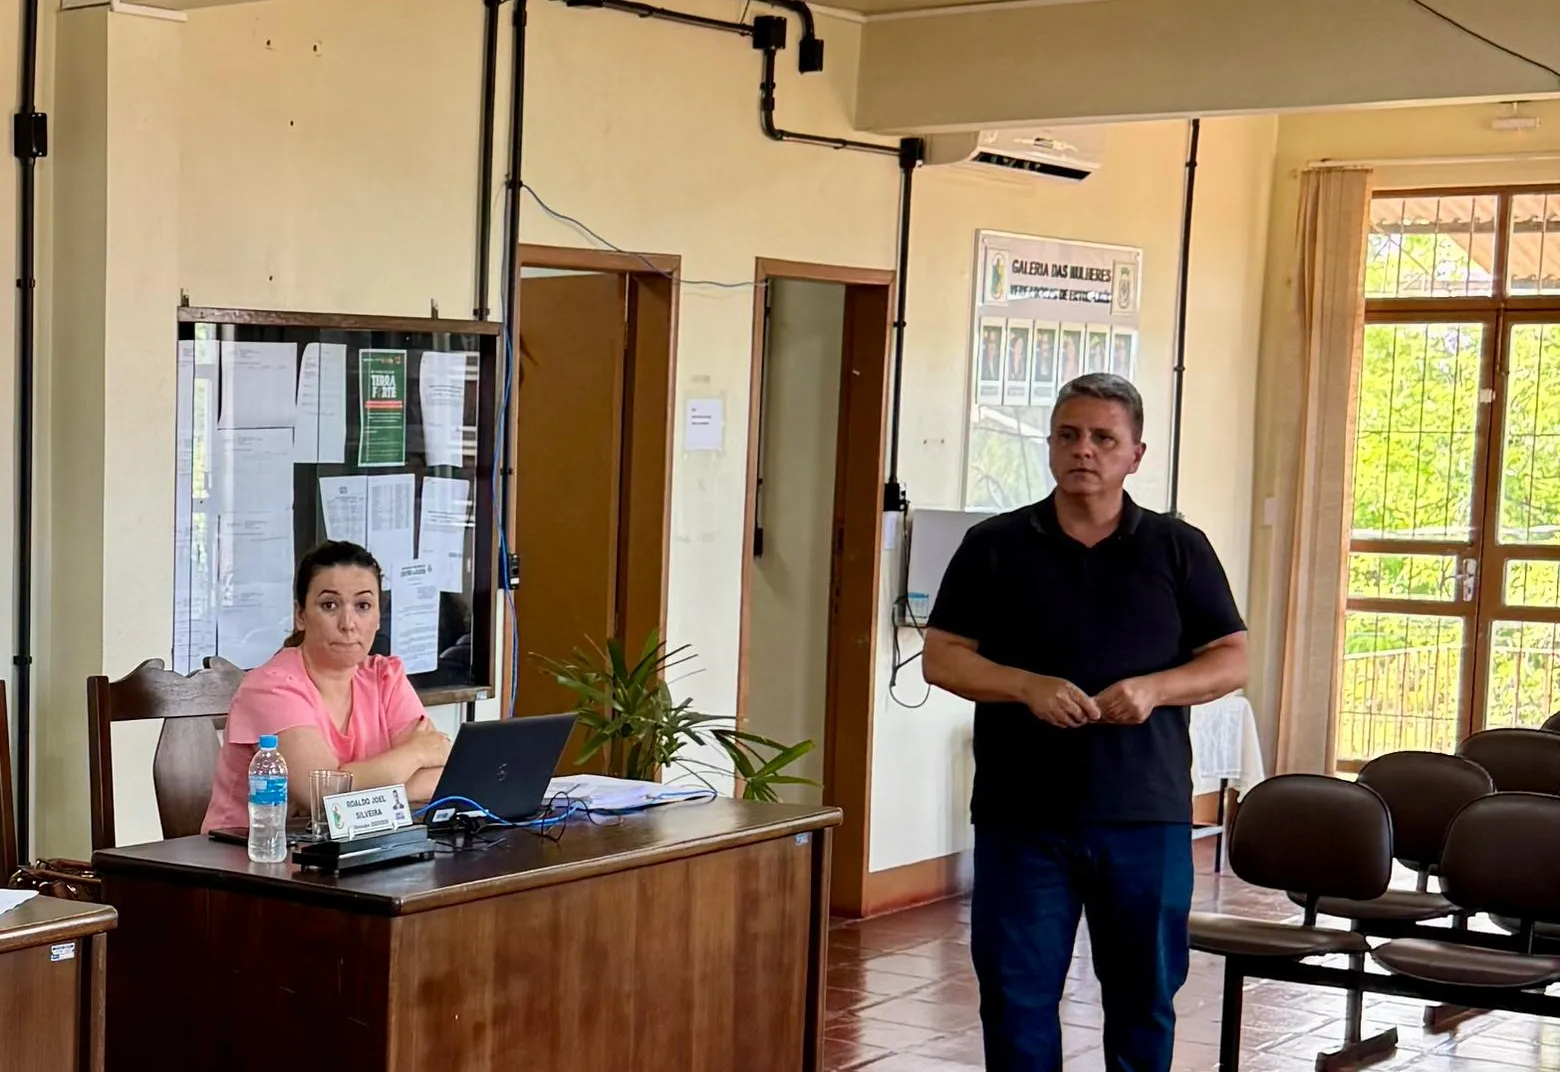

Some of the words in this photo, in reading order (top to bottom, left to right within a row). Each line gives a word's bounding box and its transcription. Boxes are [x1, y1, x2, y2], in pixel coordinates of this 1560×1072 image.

[1011, 259, 1049, 277] GALERIA
[1051, 264, 1068, 278] DAS
[1069, 265, 1112, 282] MULHERES
[371, 374, 396, 386] TERRA
[371, 795, 386, 805] JOEL
[355, 809, 383, 819] SILVEIRA
